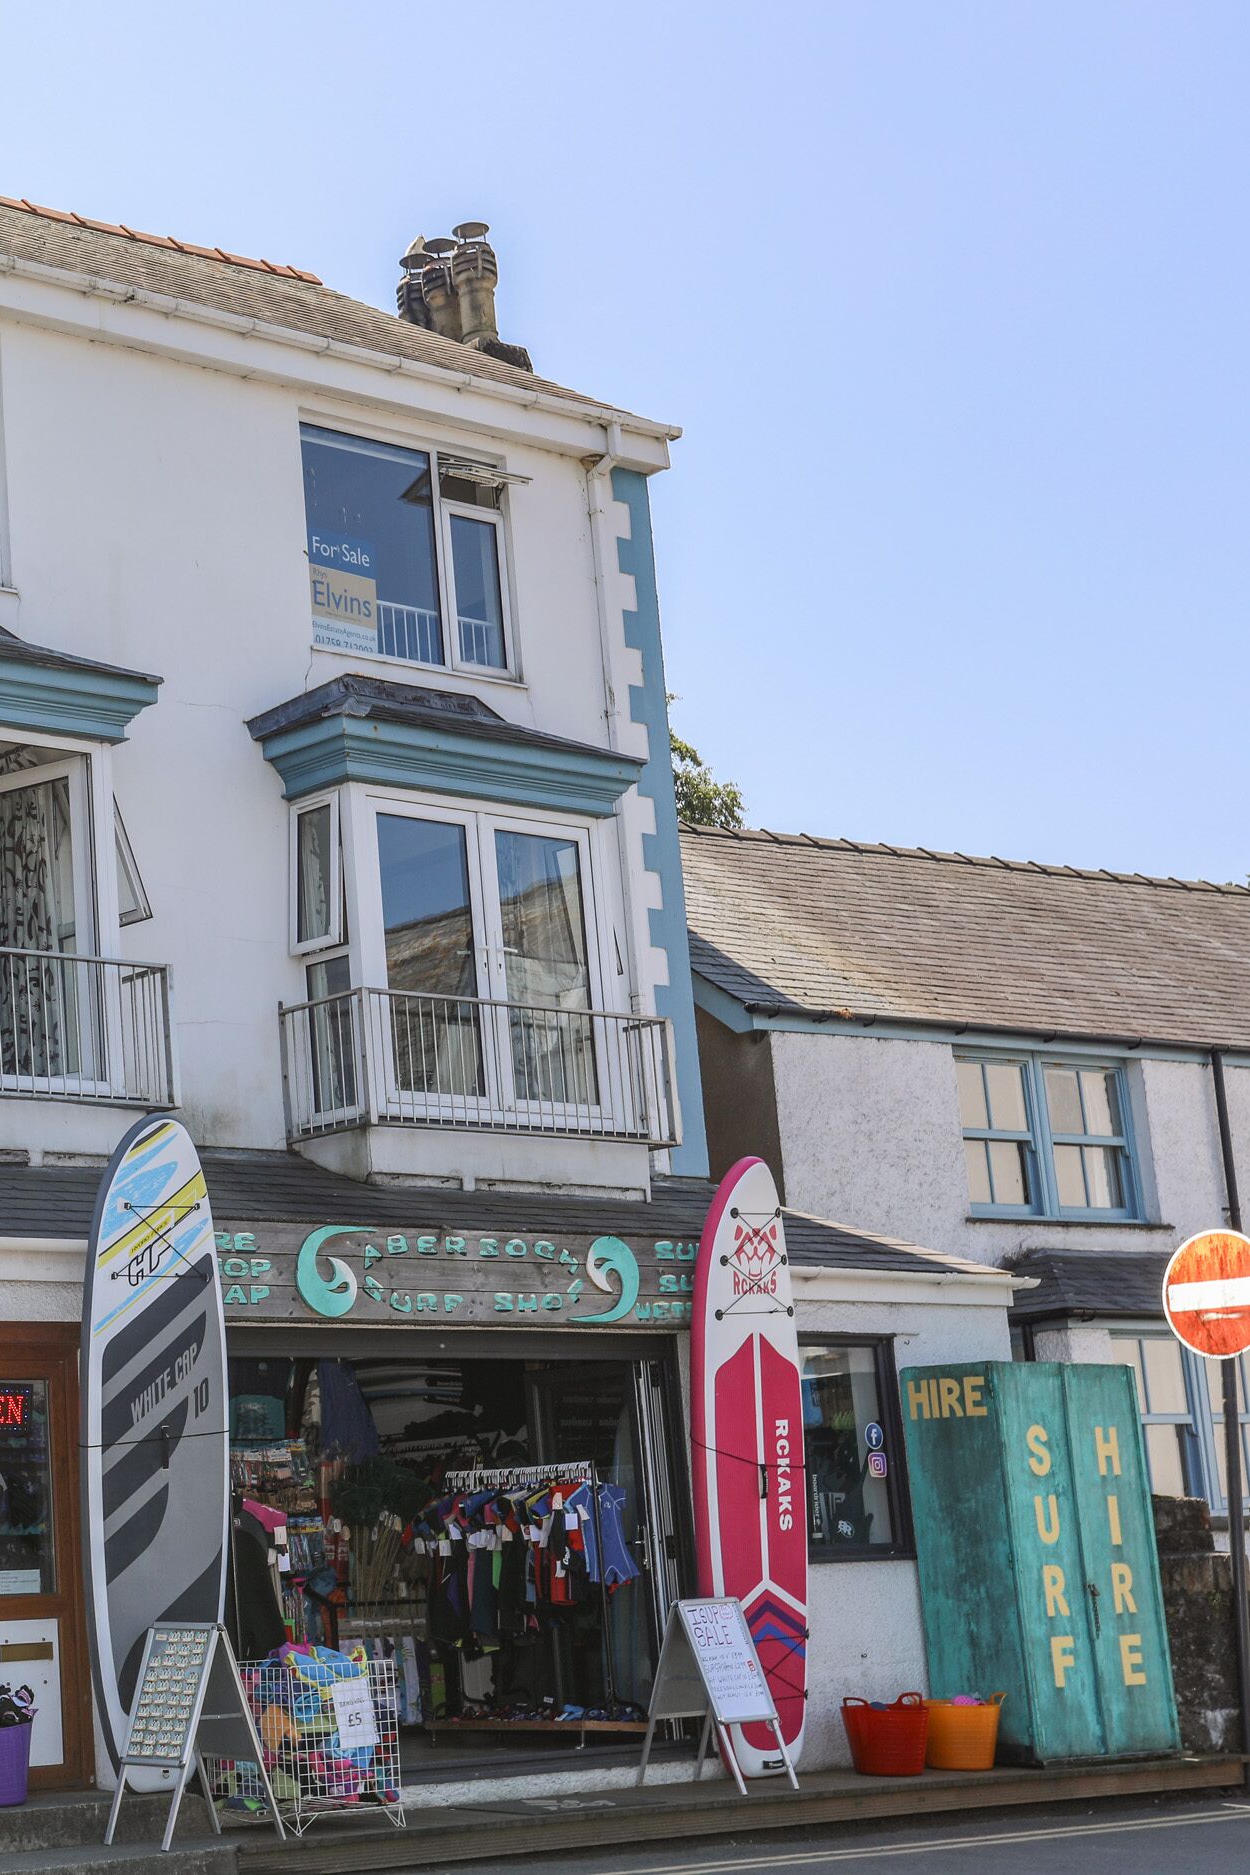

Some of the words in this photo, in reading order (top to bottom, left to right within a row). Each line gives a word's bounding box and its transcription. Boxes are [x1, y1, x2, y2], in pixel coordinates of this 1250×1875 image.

[312, 536, 337, 558] For
[342, 544, 370, 567] Sale
[313, 580, 372, 618] Elvins
[363, 1234, 579, 1276] ABERSOCH
[363, 1275, 464, 1313] SURF
[493, 1278, 584, 1314] SHOP
[131, 1367, 172, 1425] WHITE
[174, 1342, 198, 1382] CAP
[193, 1376, 210, 1420] 10
[906, 1375, 989, 1421] HIRE
[775, 1418, 794, 1532] RCKAKS
[1025, 1423, 1076, 1689] SURF
[1094, 1425, 1148, 1688] HIRE
[693, 1625, 733, 1648] SALE
[348, 1711, 362, 1728] £5
